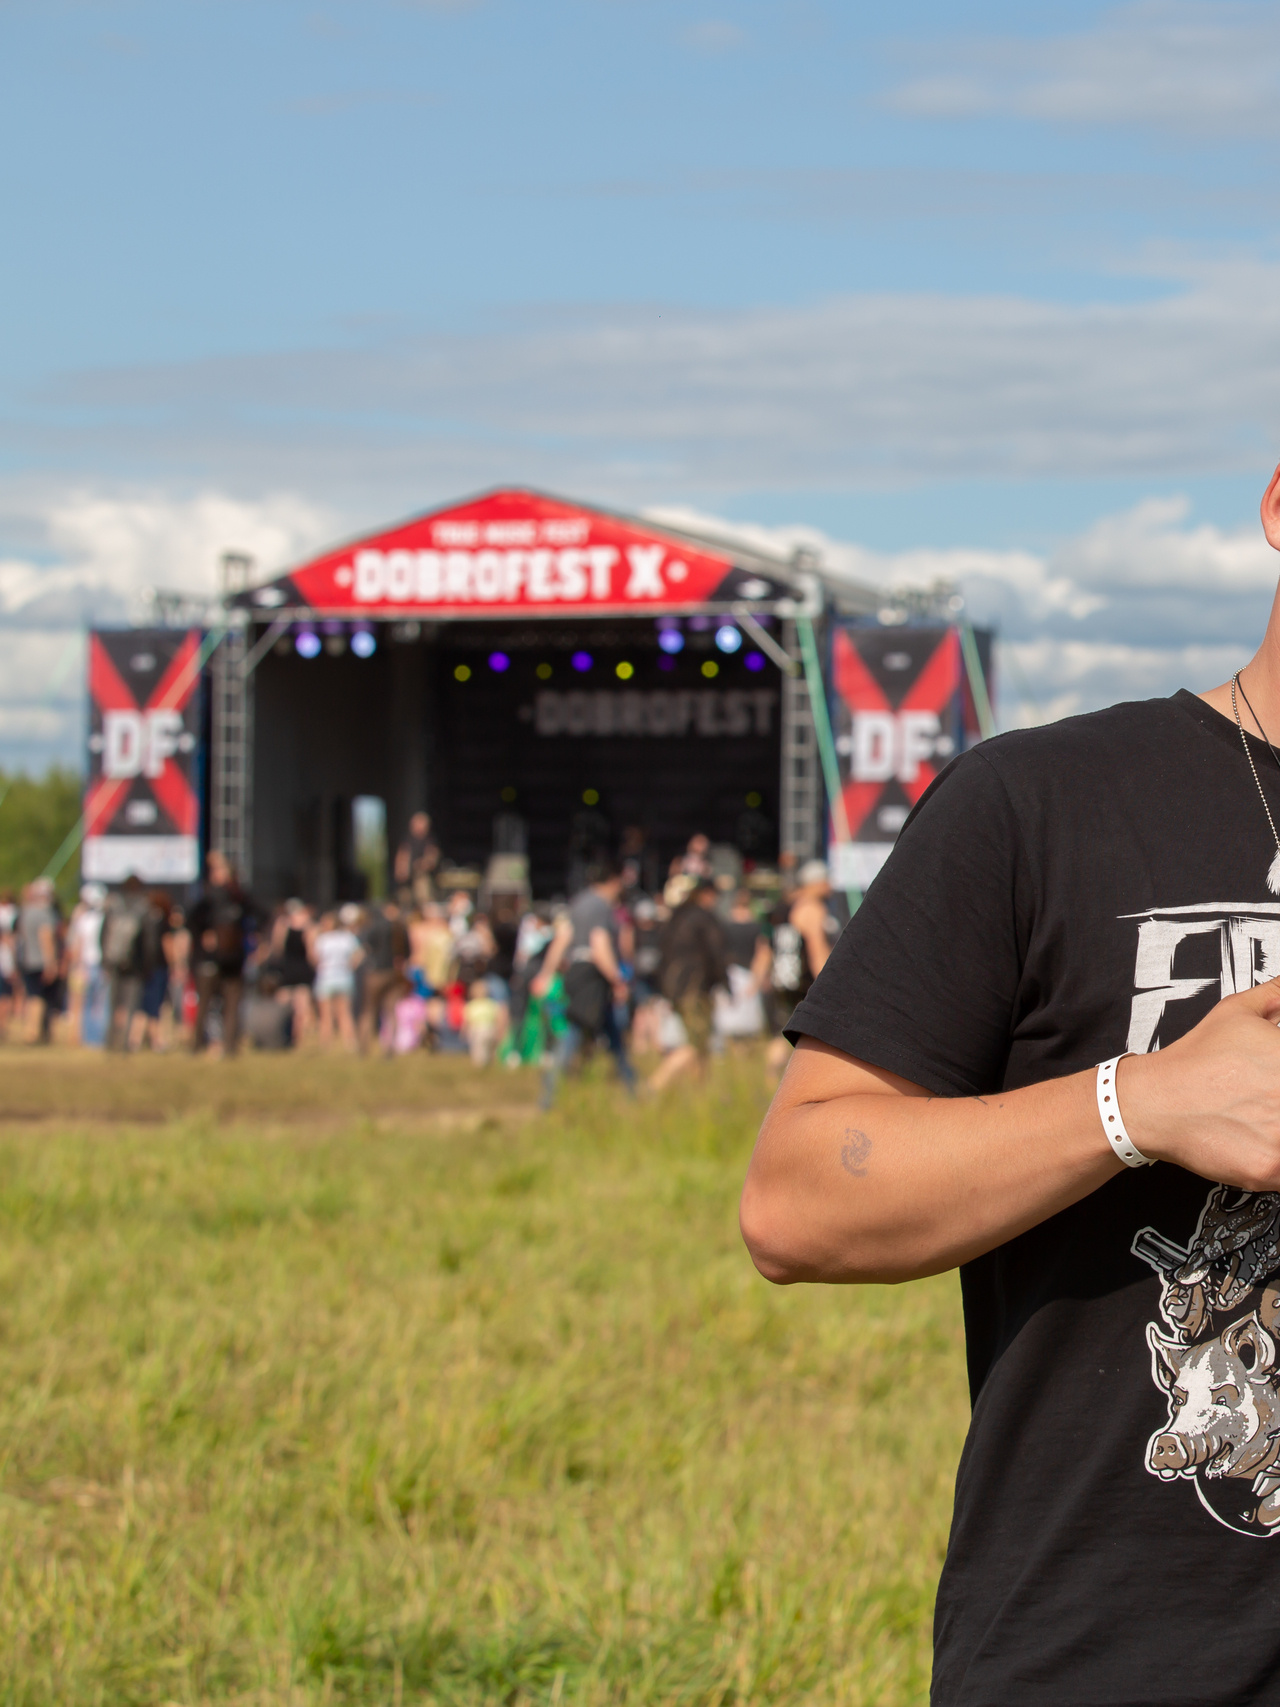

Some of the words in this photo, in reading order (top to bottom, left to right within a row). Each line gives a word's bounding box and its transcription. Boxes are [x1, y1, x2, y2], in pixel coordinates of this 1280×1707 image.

[354, 547, 617, 602] DOBROFEST
[627, 545, 666, 599] X
[103, 708, 184, 779] DF
[535, 690, 775, 736] DOBROFEST
[853, 710, 941, 783] DF
